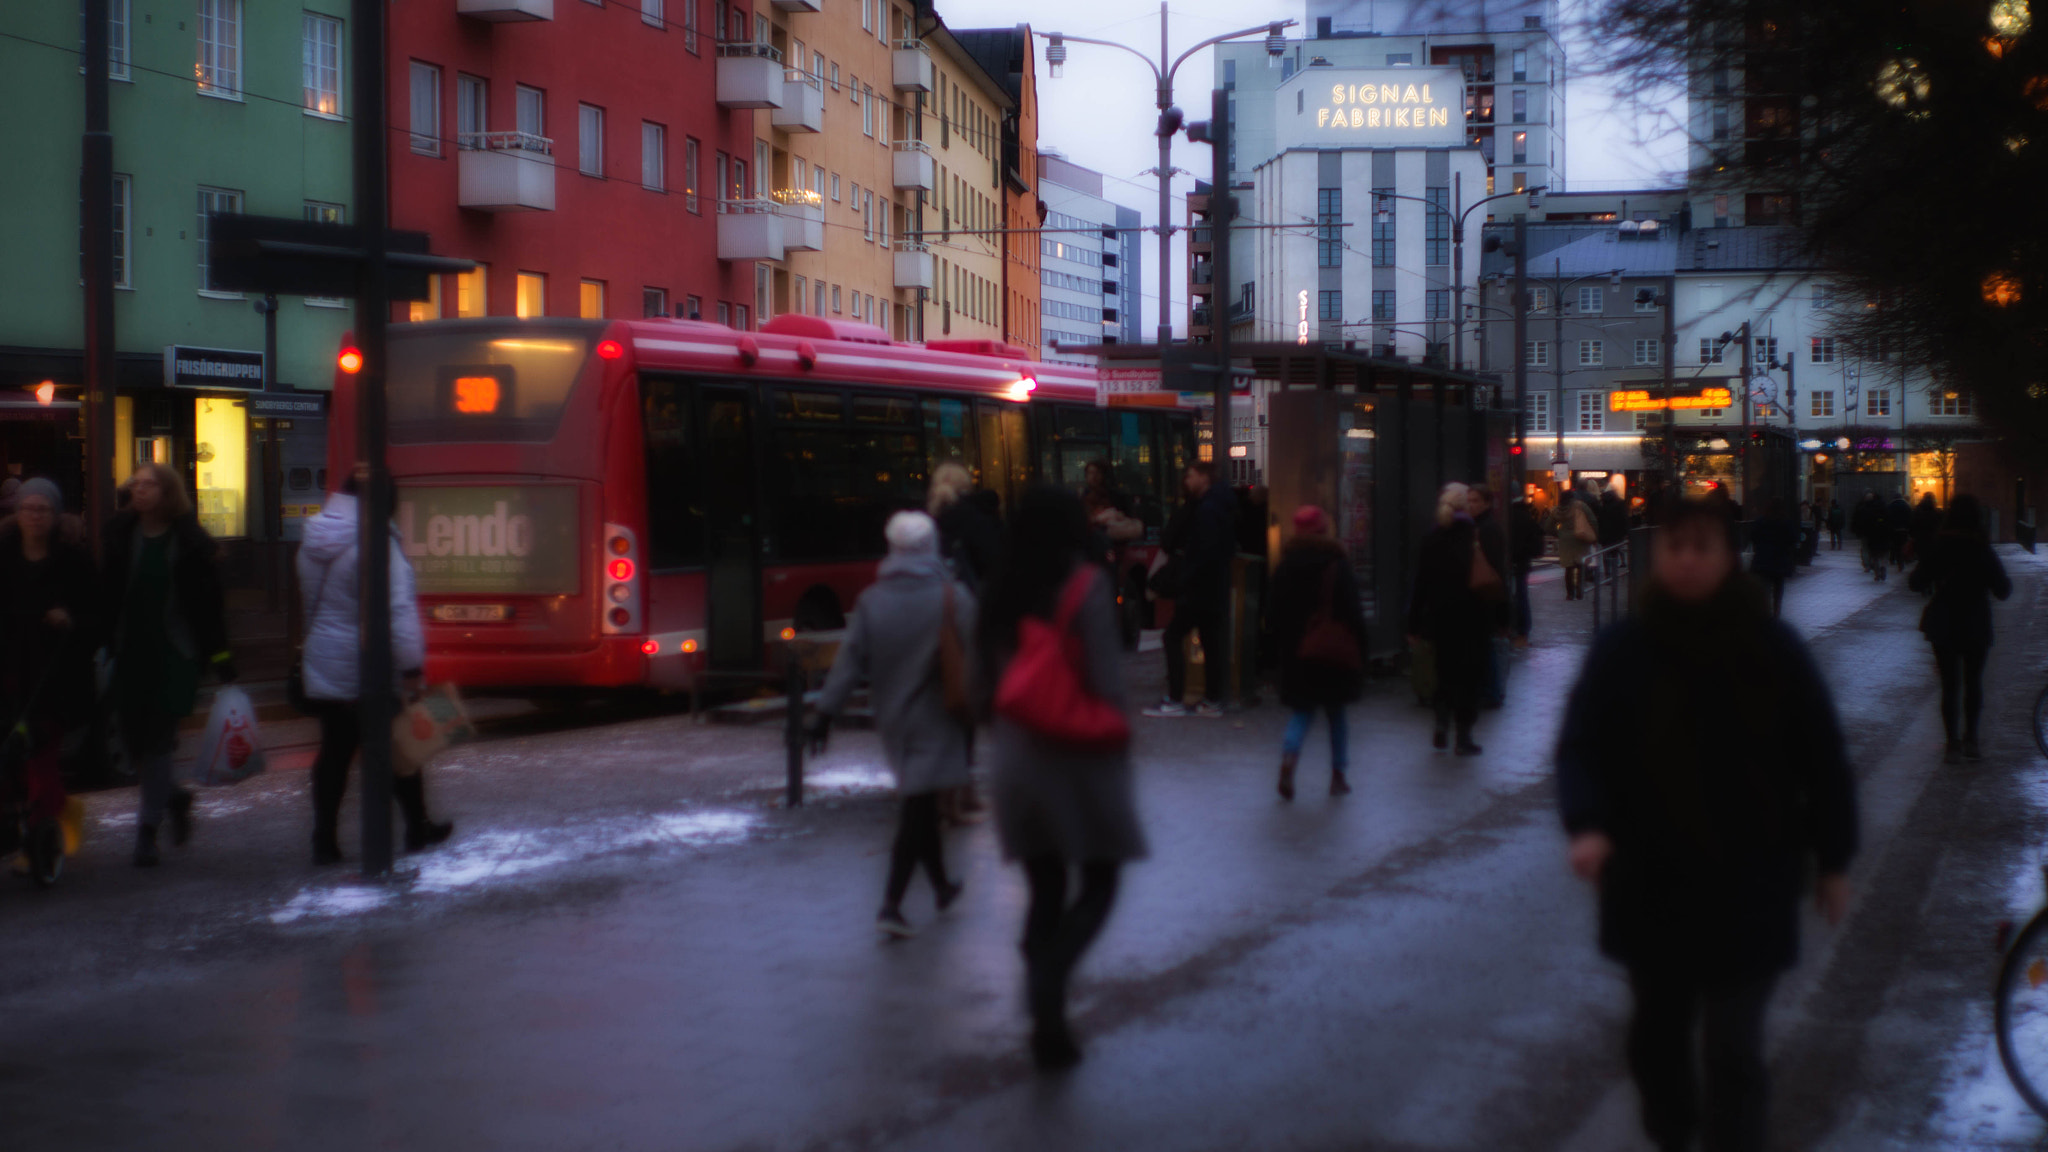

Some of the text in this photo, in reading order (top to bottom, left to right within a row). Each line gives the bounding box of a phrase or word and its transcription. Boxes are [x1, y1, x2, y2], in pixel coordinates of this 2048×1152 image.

[1332, 84, 1433, 104] SIGNAL
[1318, 107, 1448, 127] FABRIKEN
[176, 359, 261, 380] FRISÖRGRUPPEN
[400, 501, 533, 557] Lendo
